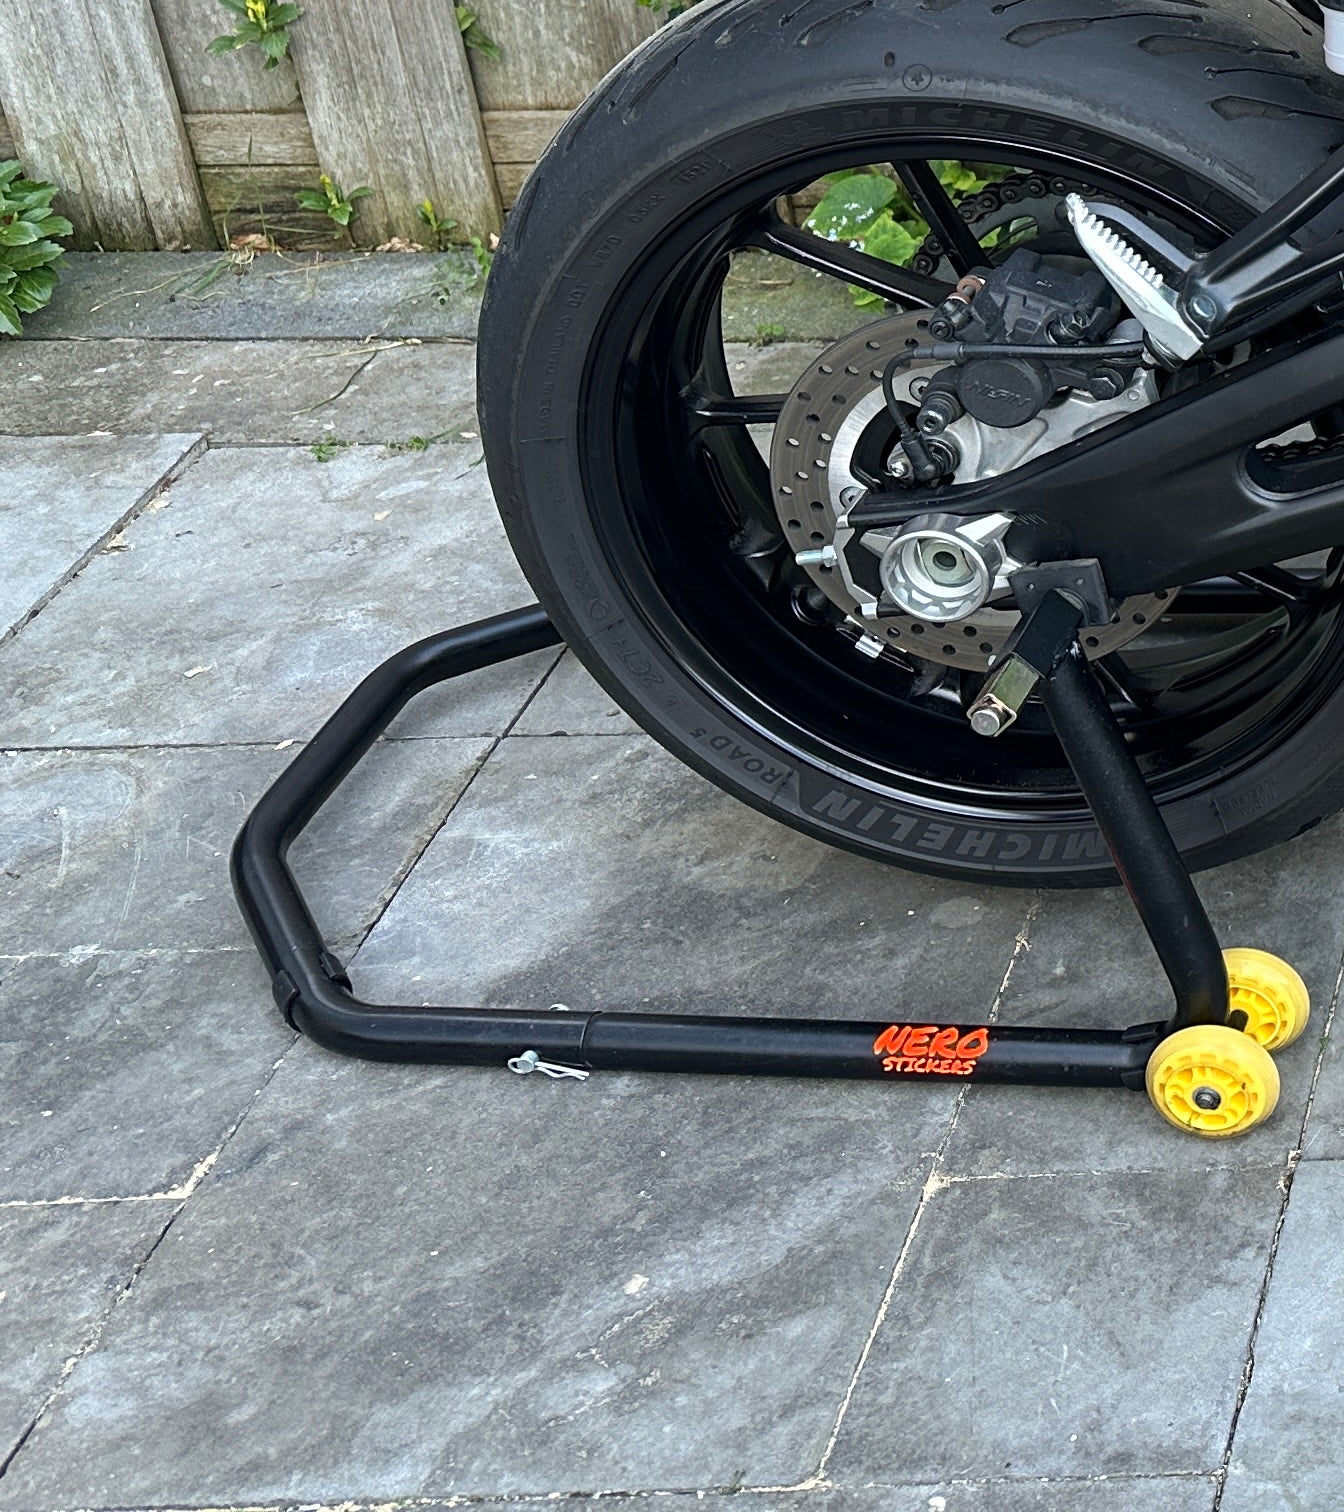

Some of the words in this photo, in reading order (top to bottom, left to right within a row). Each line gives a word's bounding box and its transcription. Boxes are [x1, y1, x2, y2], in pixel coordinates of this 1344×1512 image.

[840, 106, 1180, 187] MICHELIN
[688, 726, 708, 740] 5
[709, 735, 783, 785] ROAD
[812, 791, 1112, 860] MICHELIN
[873, 1025, 989, 1059] NERO
[882, 1056, 977, 1075] STICKERS
